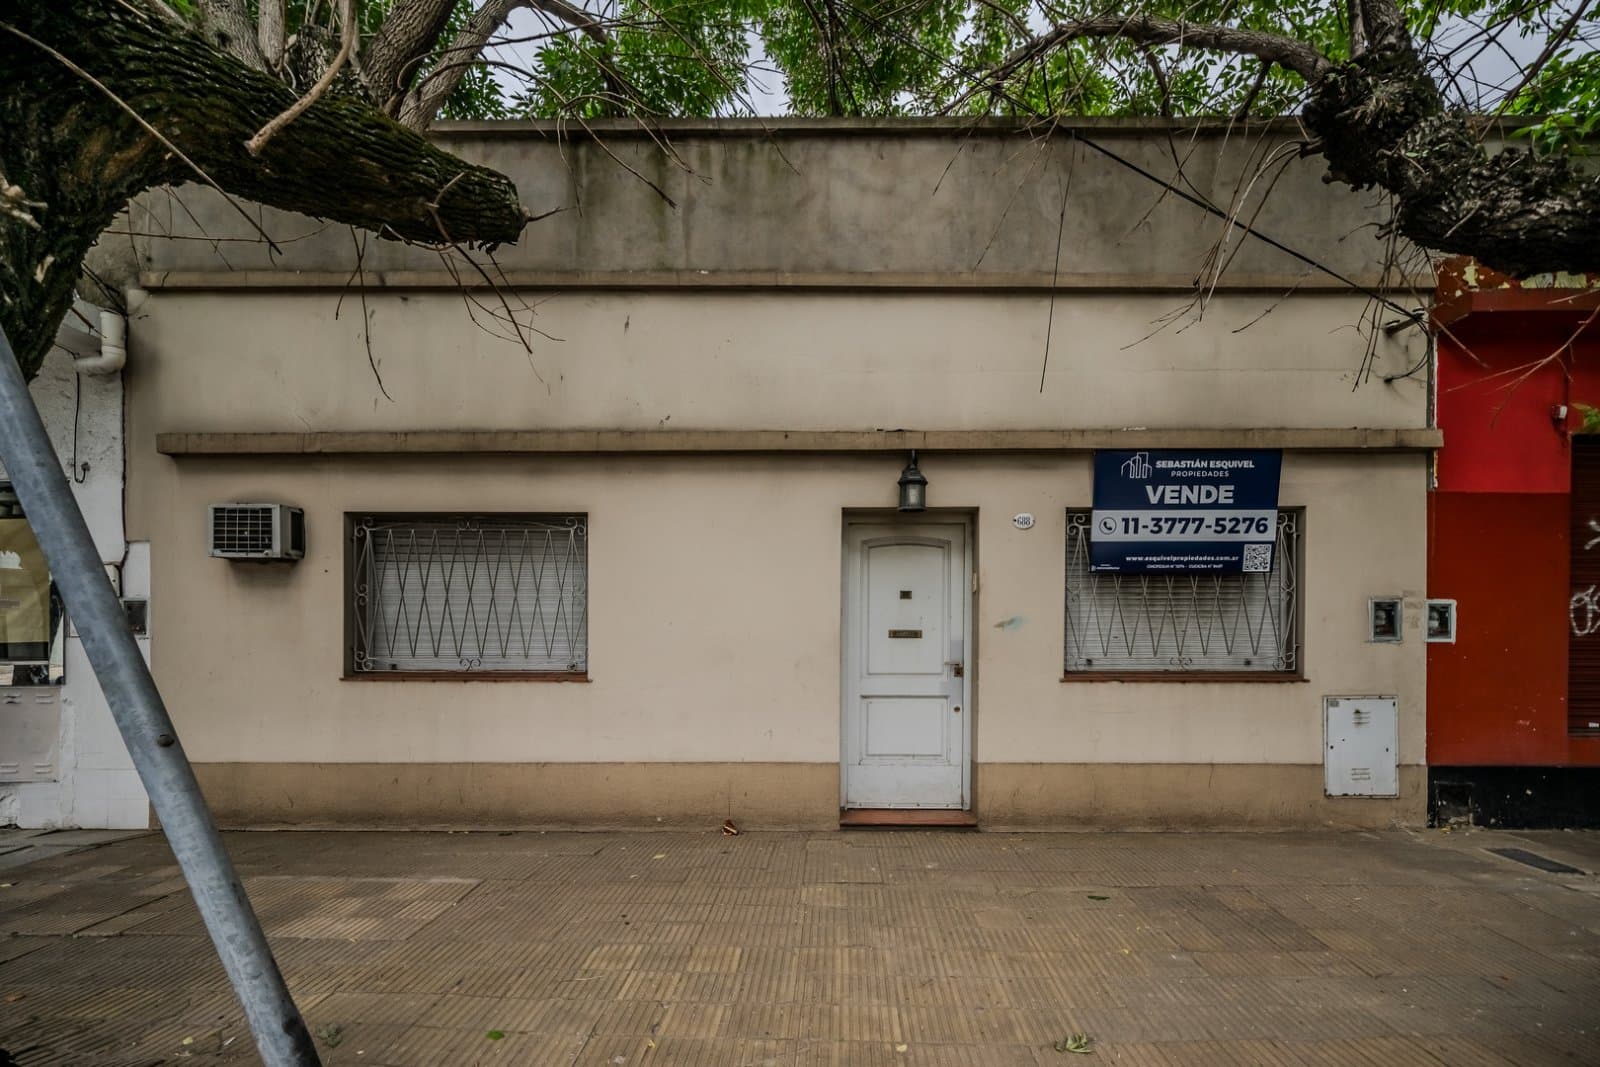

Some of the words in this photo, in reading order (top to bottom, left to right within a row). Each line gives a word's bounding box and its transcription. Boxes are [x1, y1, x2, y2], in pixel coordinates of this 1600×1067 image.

[1155, 458, 1208, 469] SEBASTIÁN
[1209, 460, 1255, 469] ESQUIVEL
[1145, 485, 1235, 504] VENDE
[1121, 517, 1269, 535] 11-3777-5276
[1125, 554, 1239, 562] www.esquivelpropiedades.com.ar
